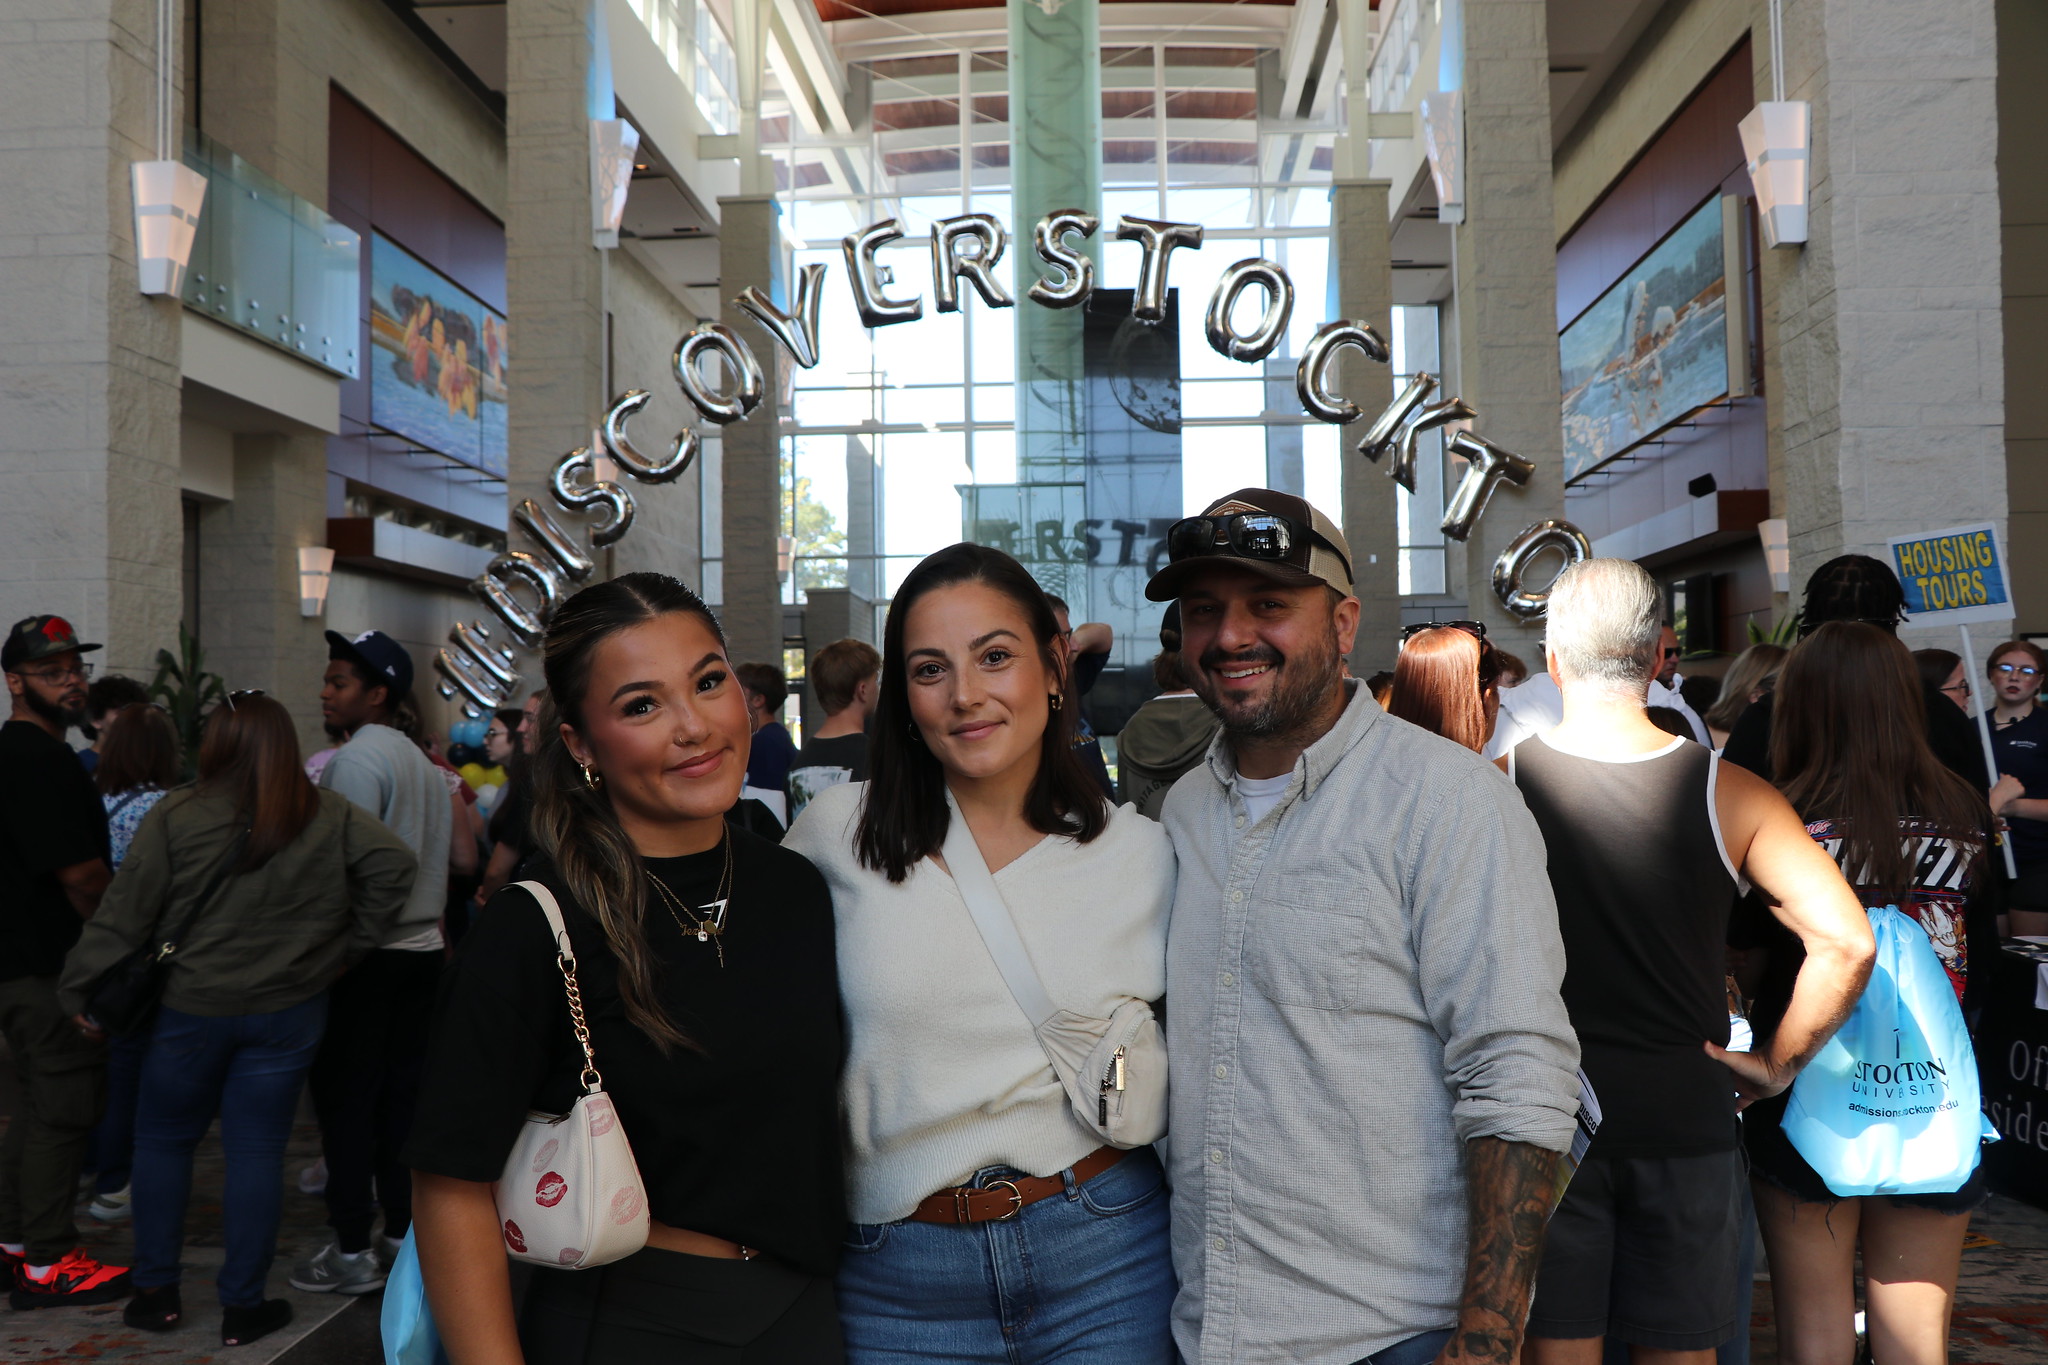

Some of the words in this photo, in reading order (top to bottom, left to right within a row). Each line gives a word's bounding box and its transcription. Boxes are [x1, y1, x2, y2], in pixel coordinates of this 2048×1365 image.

[1897, 531, 1993, 578] HOUSING
[1916, 570, 1988, 611] TOURS
[1577, 1102, 1599, 1131] DISCO
